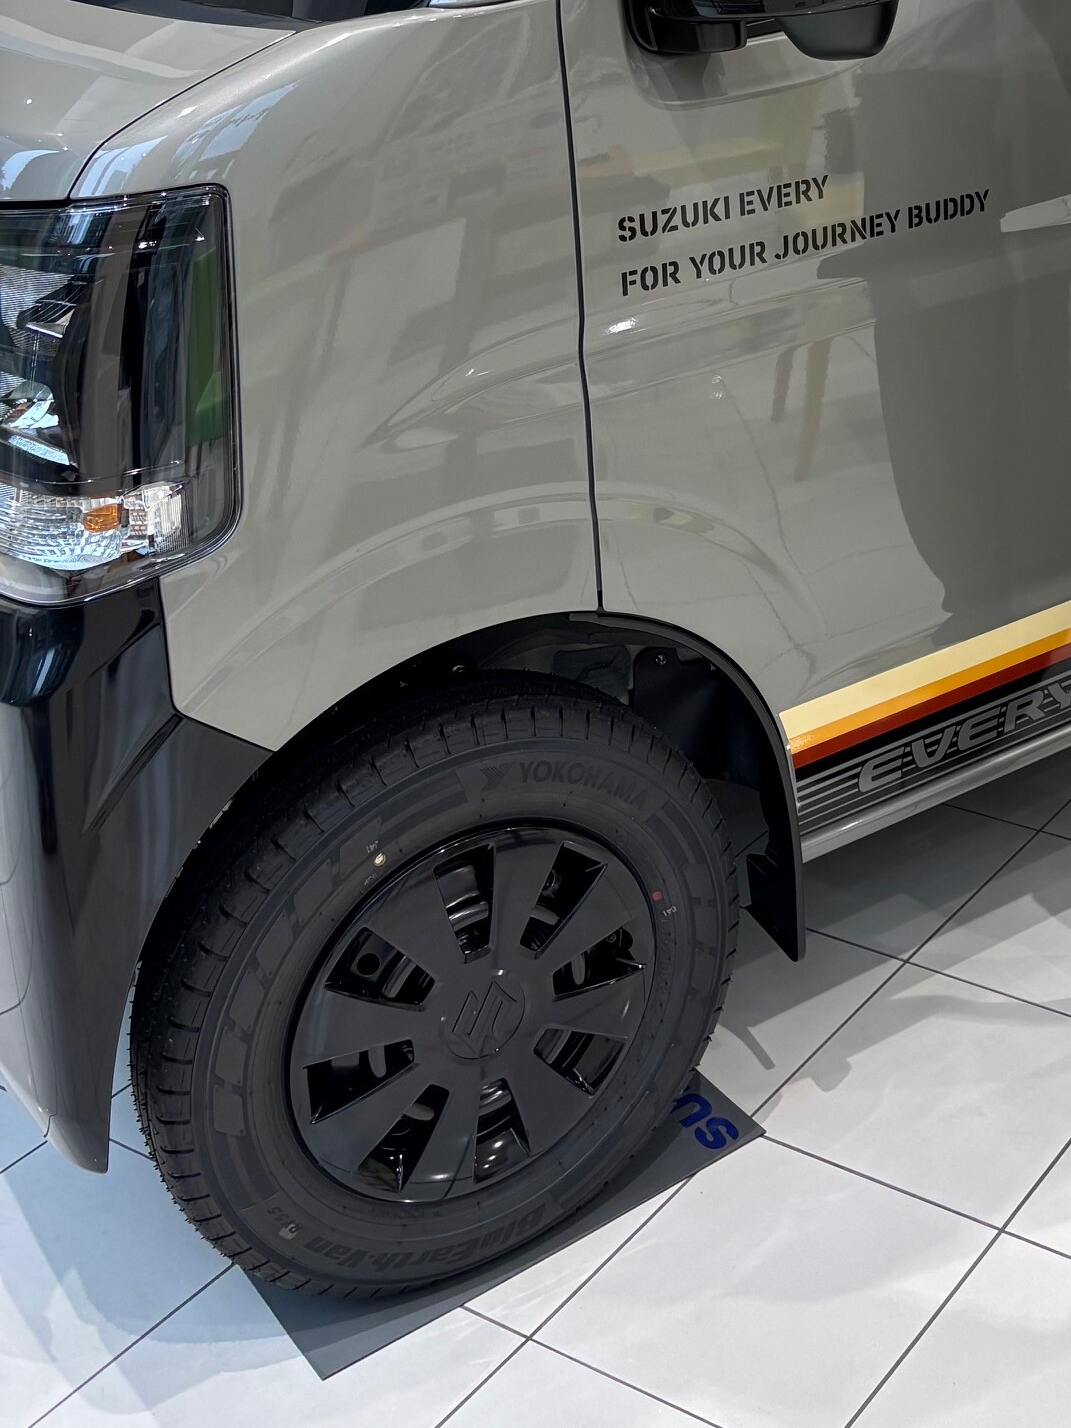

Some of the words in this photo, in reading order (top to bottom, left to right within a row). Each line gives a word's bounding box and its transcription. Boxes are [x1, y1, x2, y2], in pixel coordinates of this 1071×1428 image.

[618, 195, 731, 242] SUZUKI
[740, 174, 829, 217] EVERY
[620, 260, 682, 297] FOR
[688, 240, 768, 280] YOUR
[774, 208, 901, 261] JOURNEY
[907, 188, 991, 230] BUDDY
[518, 759, 651, 812] YOKOHAMA
